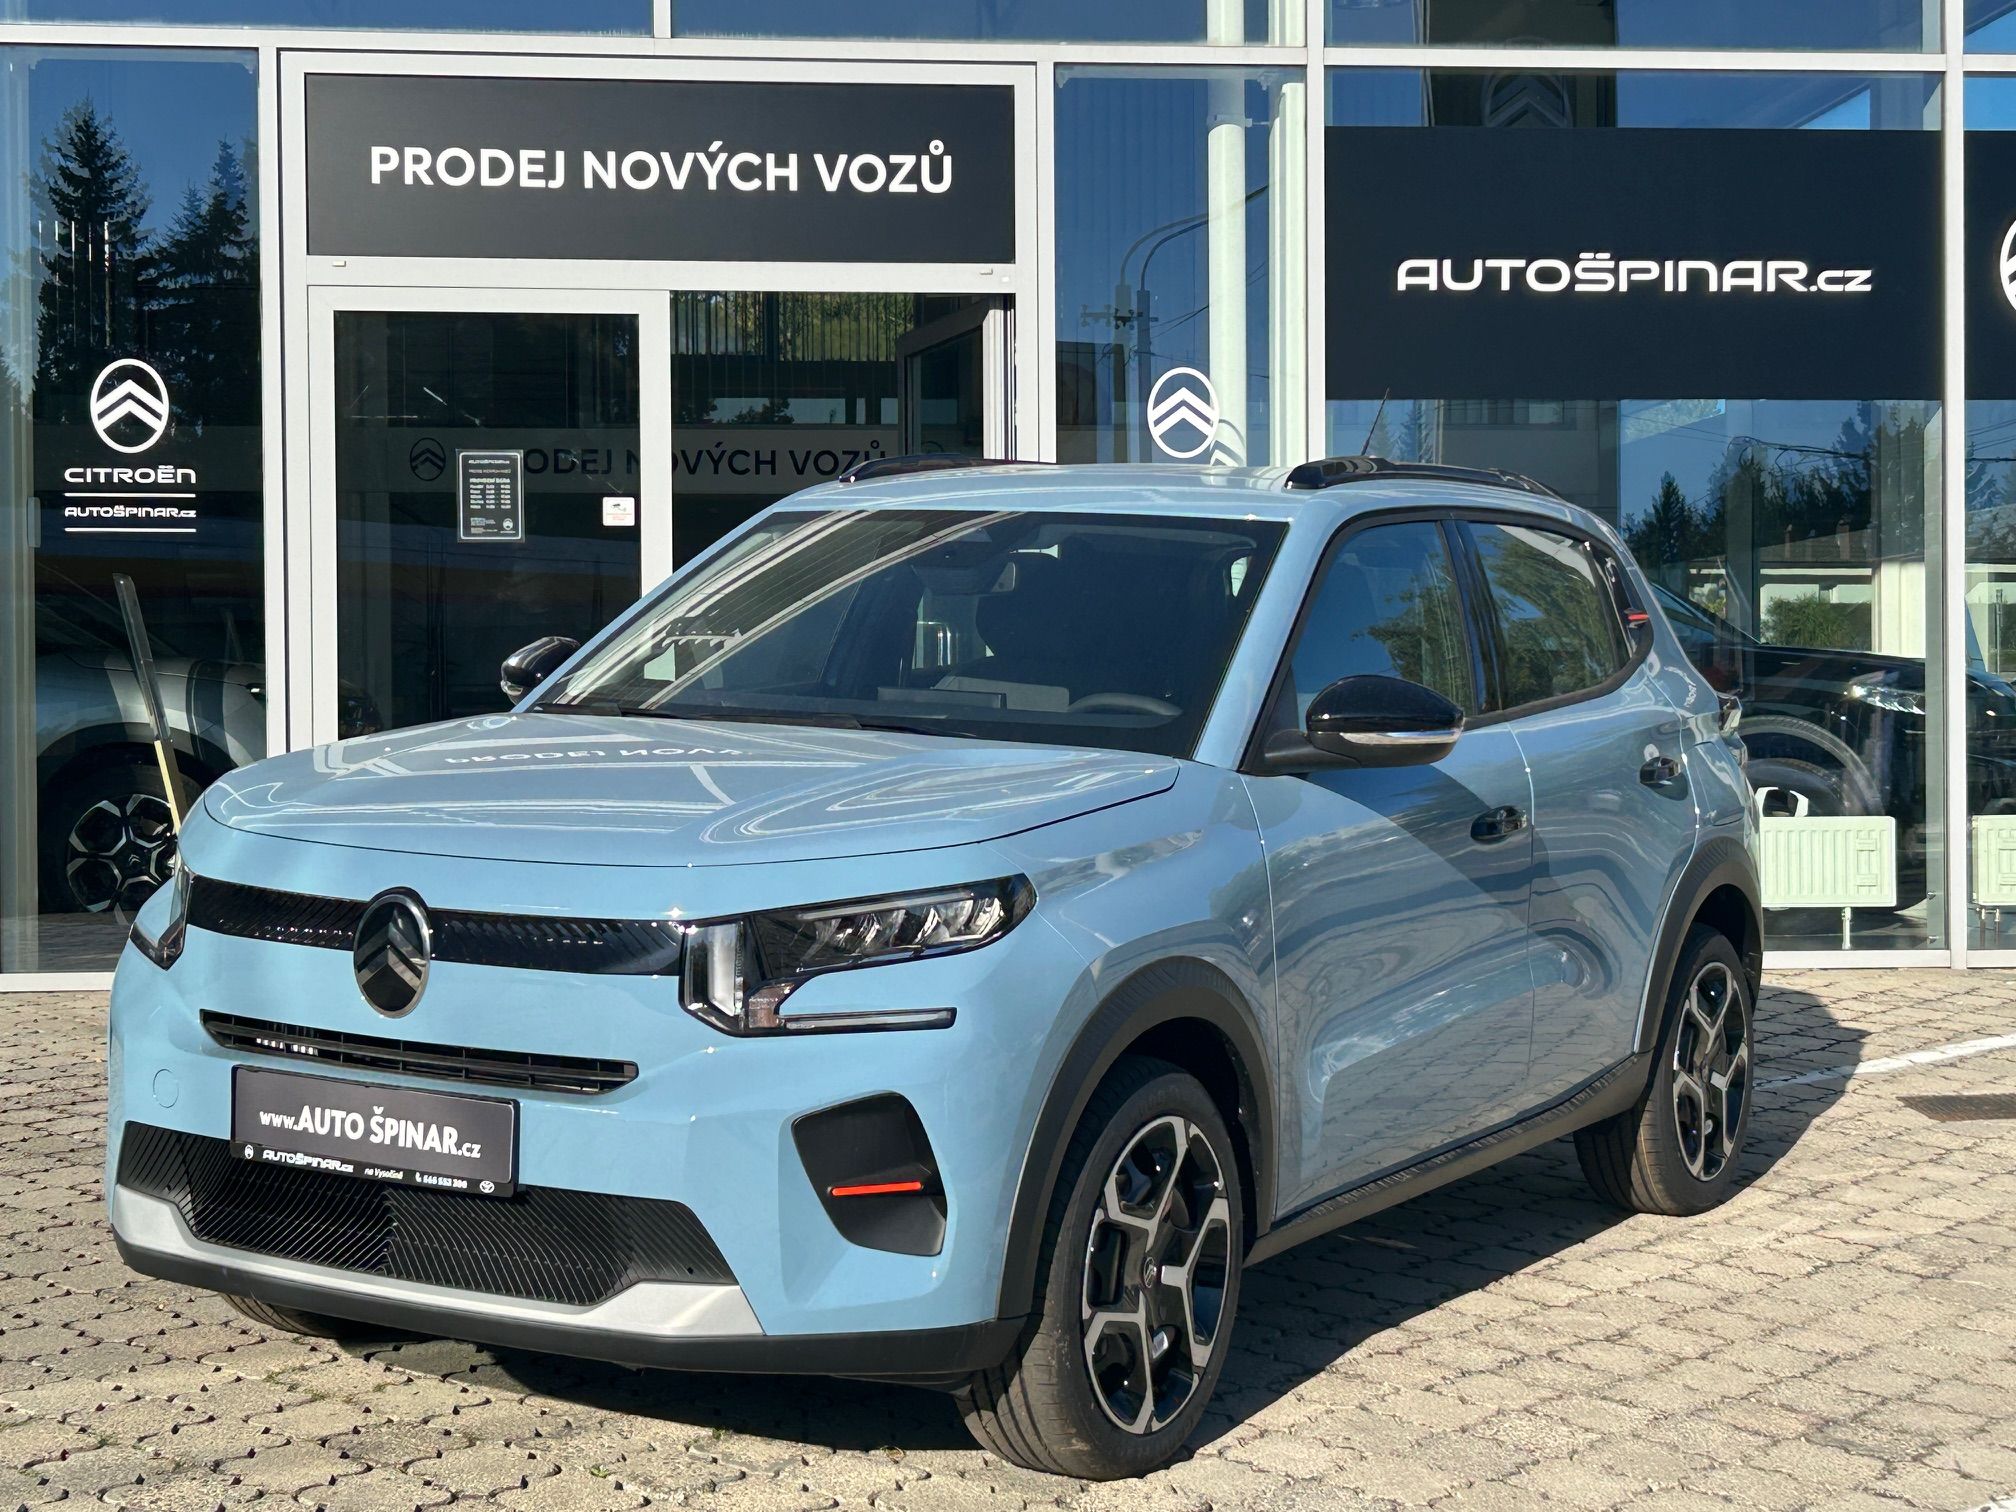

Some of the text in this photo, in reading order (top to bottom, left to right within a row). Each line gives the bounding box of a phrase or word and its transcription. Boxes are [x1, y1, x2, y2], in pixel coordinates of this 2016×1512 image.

[370, 139, 953, 194] PRODEJ NOVÝCH VOZŮ
[64, 464, 197, 484] CITROËN
[524, 448, 612, 475] ODEJ
[626, 440, 777, 476] NVÝCH
[259, 1104, 482, 1159] www.AUTO ŠPINAR.cz
